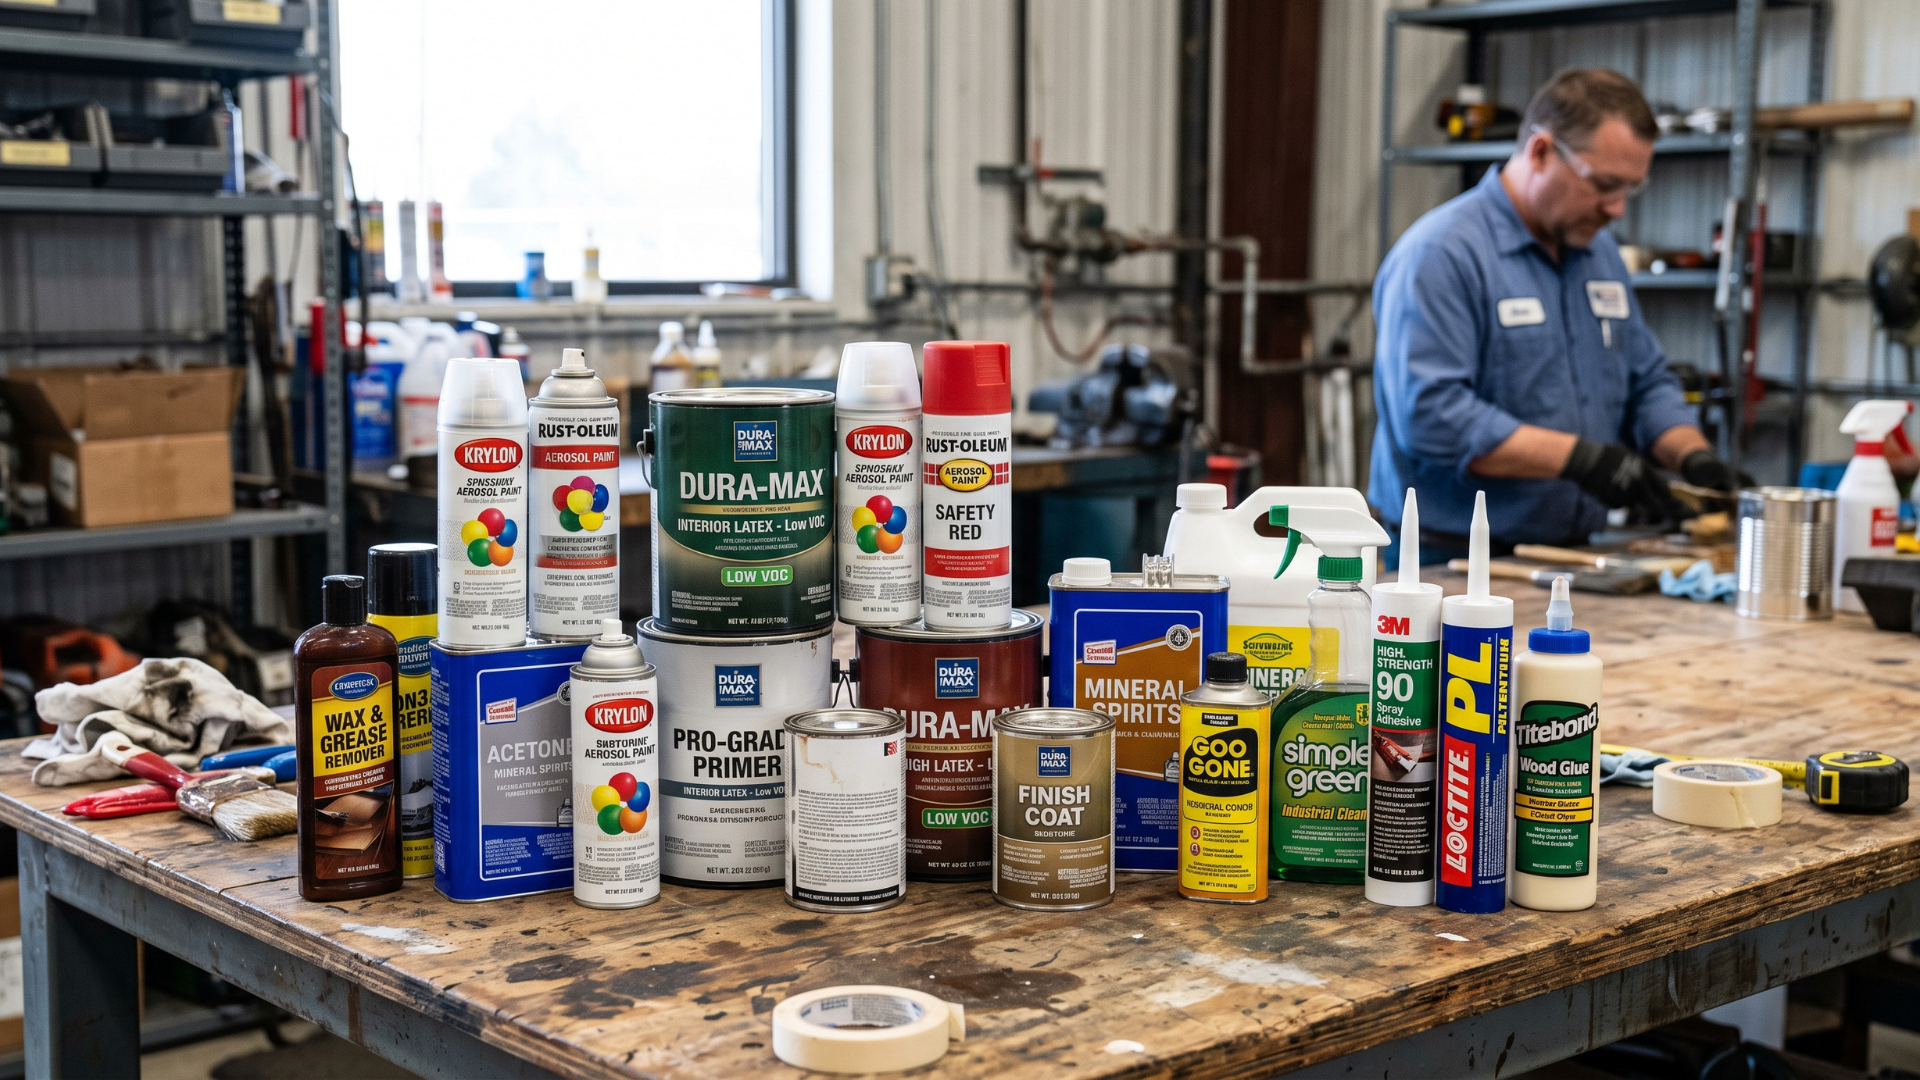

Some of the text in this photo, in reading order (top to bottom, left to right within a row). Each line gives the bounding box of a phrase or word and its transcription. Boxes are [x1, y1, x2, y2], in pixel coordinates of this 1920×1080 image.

[538, 423, 618, 438] RUST-OLEUM
[854, 433, 905, 451] KRYLON
[926, 437, 1007, 453] RUST-OLEUM
[464, 446, 517, 464] KRYLON
[545, 451, 615, 463] AEROSOL PAINT
[845, 472, 914, 483] AEROSOL PAINT
[945, 467, 987, 475] AEROSOL
[952, 476, 979, 484] PAINT
[456, 486, 522, 497] AEROSOL PAINT
[680, 468, 824, 501] DURA-MAX
[935, 504, 995, 520] SAFETY
[677, 518, 731, 533] INTERIOR
[734, 520, 773, 533] LATEX
[785, 519, 807, 531] Low
[808, 515, 825, 529] VOC
[949, 524, 982, 540] RED
[727, 569, 789, 583] LOW VOC
[1377, 615, 1410, 636] 3M
[1377, 657, 1433, 670] STRENGTH
[1377, 670, 1414, 702] 90
[1446, 642, 1493, 734] PL
[594, 704, 648, 725] KRYLON
[1376, 701, 1404, 716] Spray
[324, 704, 383, 733] WAX &
[1376, 713, 1422, 726] Adhesive
[1516, 706, 1597, 745] Titebond
[320, 723, 387, 754] GREASE
[673, 728, 785, 753] PRO-GRAD
[1192, 736, 1247, 758] GOO
[325, 744, 385, 770] REMOVER
[585, 743, 656, 759] AEROSOL PAINT
[1284, 735, 1369, 771] simple
[494, 761, 573, 779] MINERAL SPIRITS
[693, 755, 782, 779] PRIMER
[934, 759, 974, 772] LATEX
[1188, 757, 1251, 778] GONE
[1519, 756, 1590, 776] Wood Glue
[683, 786, 720, 797] INTERIOR
[722, 788, 748, 797] LATEX
[755, 788, 772, 796] Low
[773, 786, 784, 795] VO
[1286, 768, 1369, 797] green
[1018, 784, 1090, 805] FINISH
[927, 811, 989, 825] LOW VOC
[1025, 806, 1085, 826] COAT
[1281, 803, 1335, 820] Industrial
[1445, 748, 1470, 873] LOCTITE
